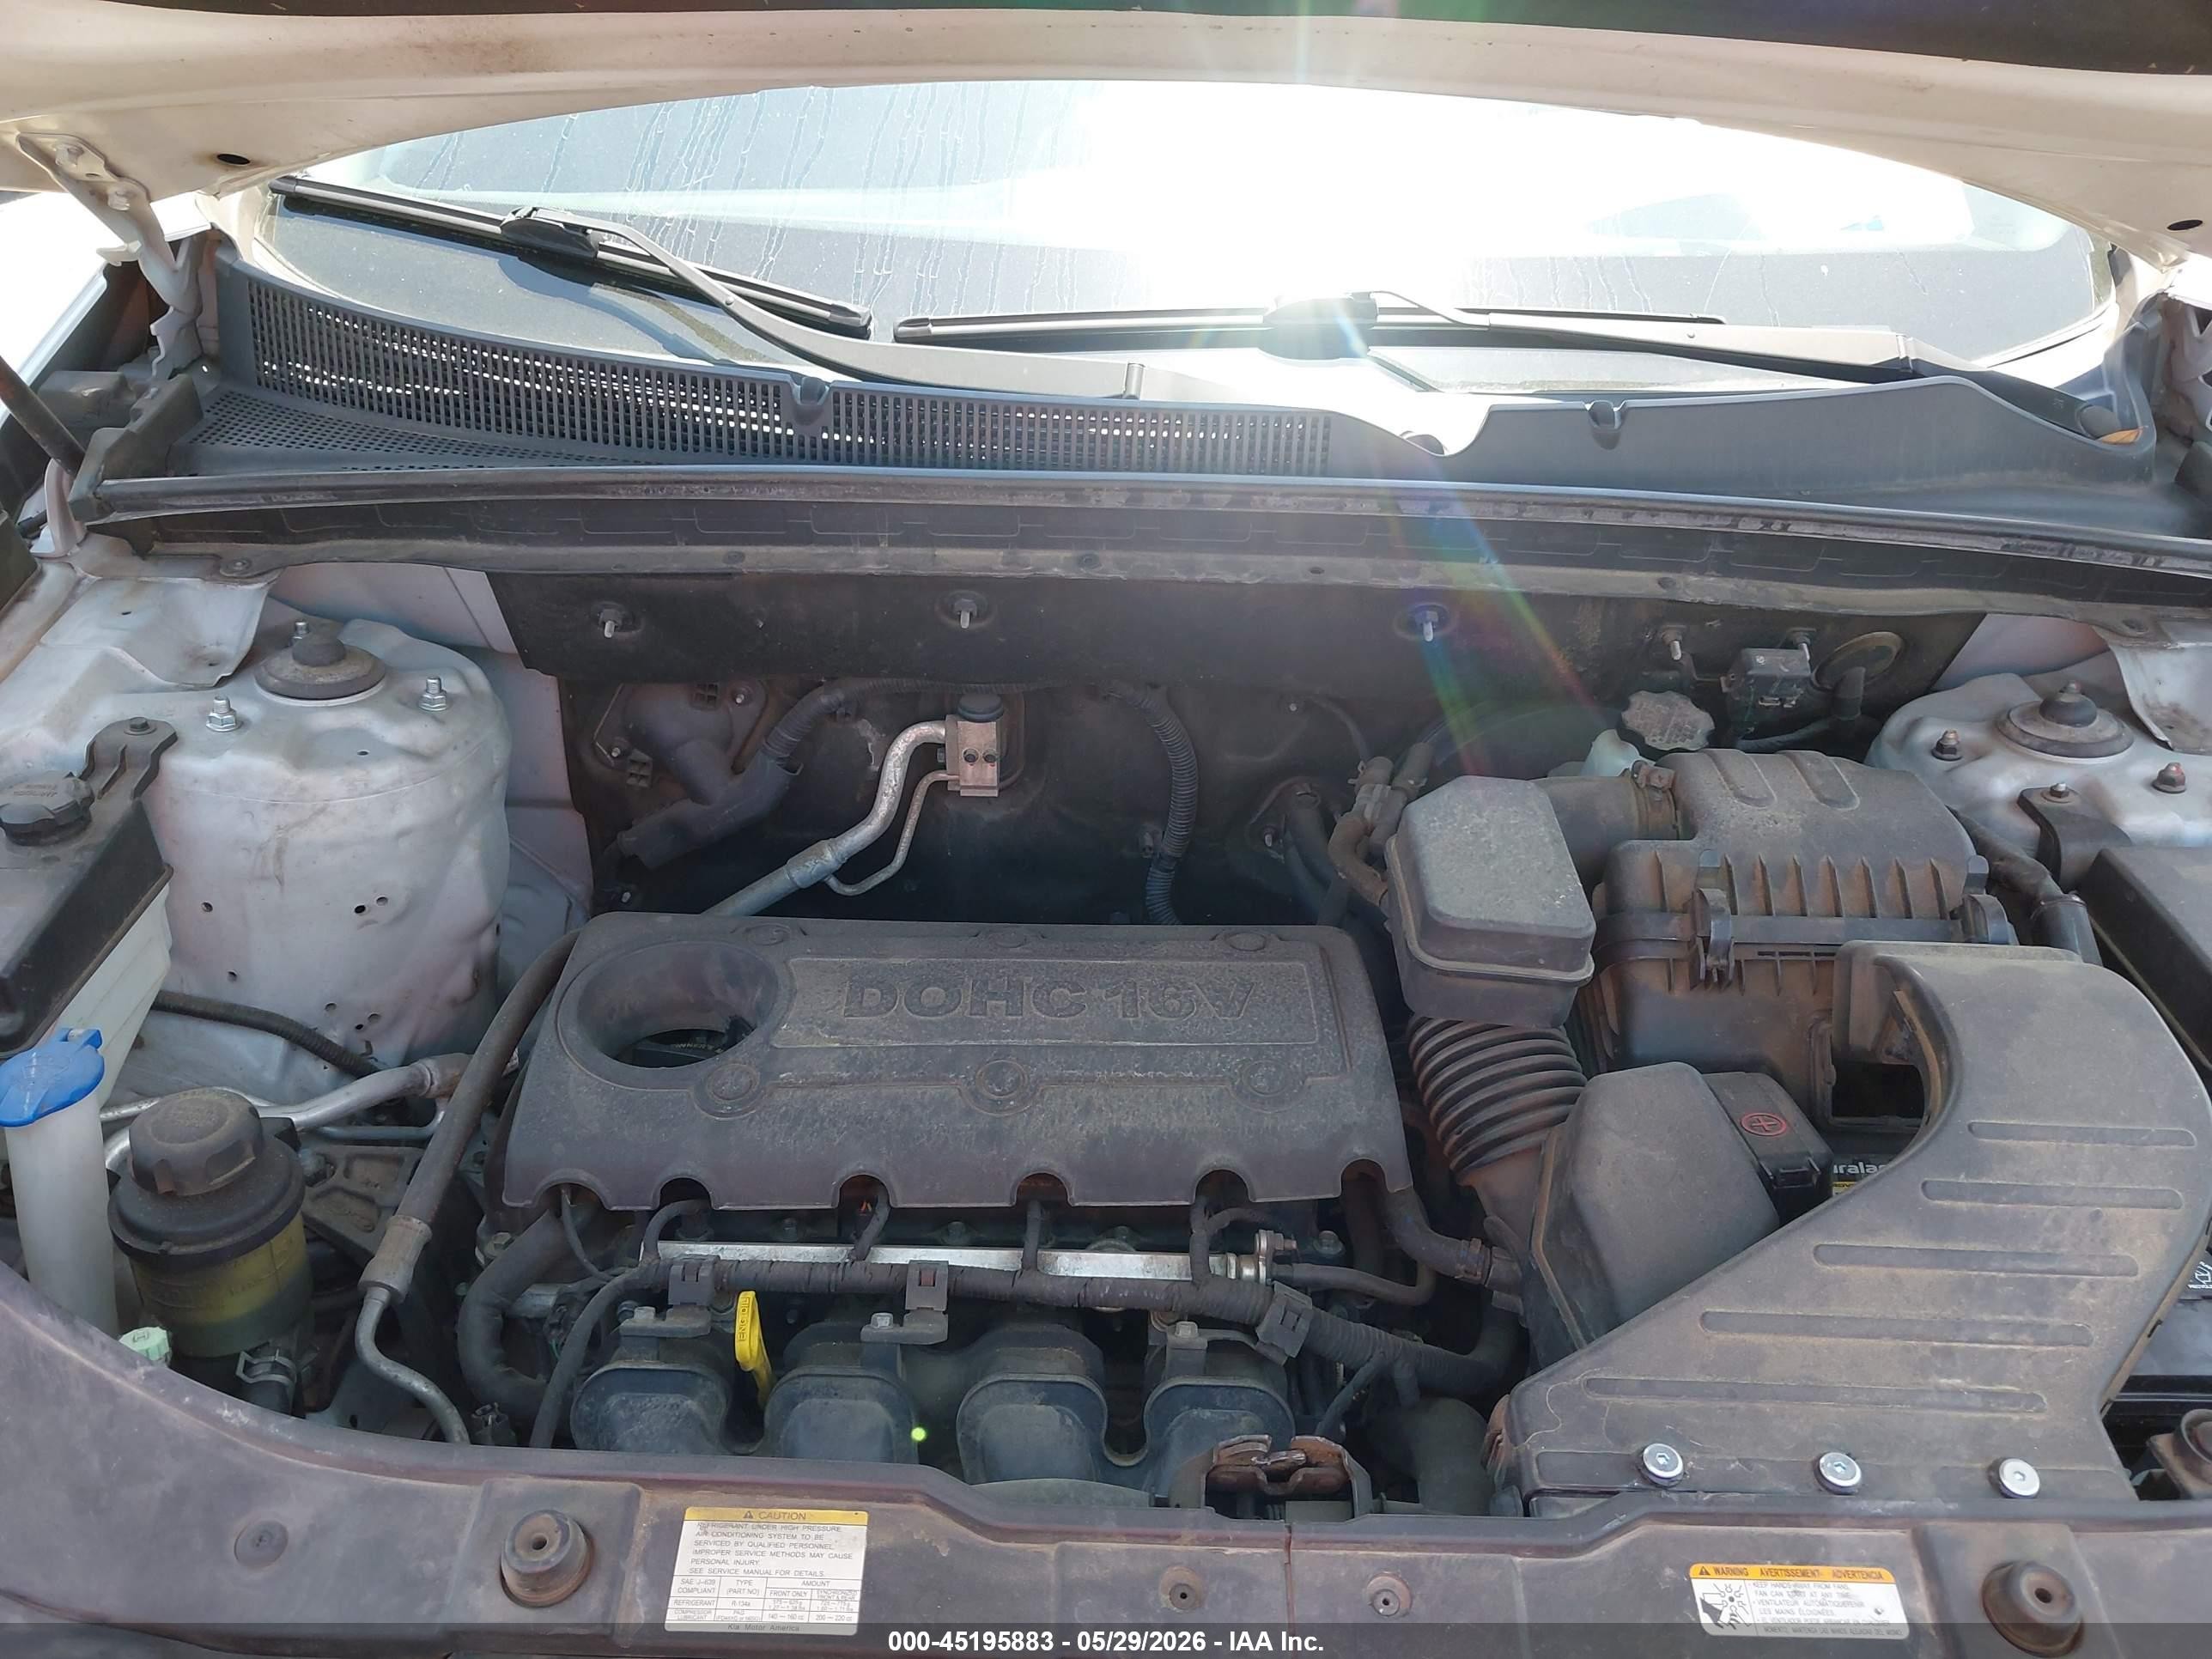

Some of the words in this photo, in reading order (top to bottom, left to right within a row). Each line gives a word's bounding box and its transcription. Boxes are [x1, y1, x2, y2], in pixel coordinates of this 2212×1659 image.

[843, 979, 1086, 1019] DOHC
[1105, 979, 1257, 1019] 16V
[758, 1511, 806, 1520] CAUTION
[1713, 1568, 1749, 1577] WARNING
[1759, 1568, 1820, 1577] AVERTISSEMENT
[1832, 1570, 1883, 1579] ADVERTENCIA
